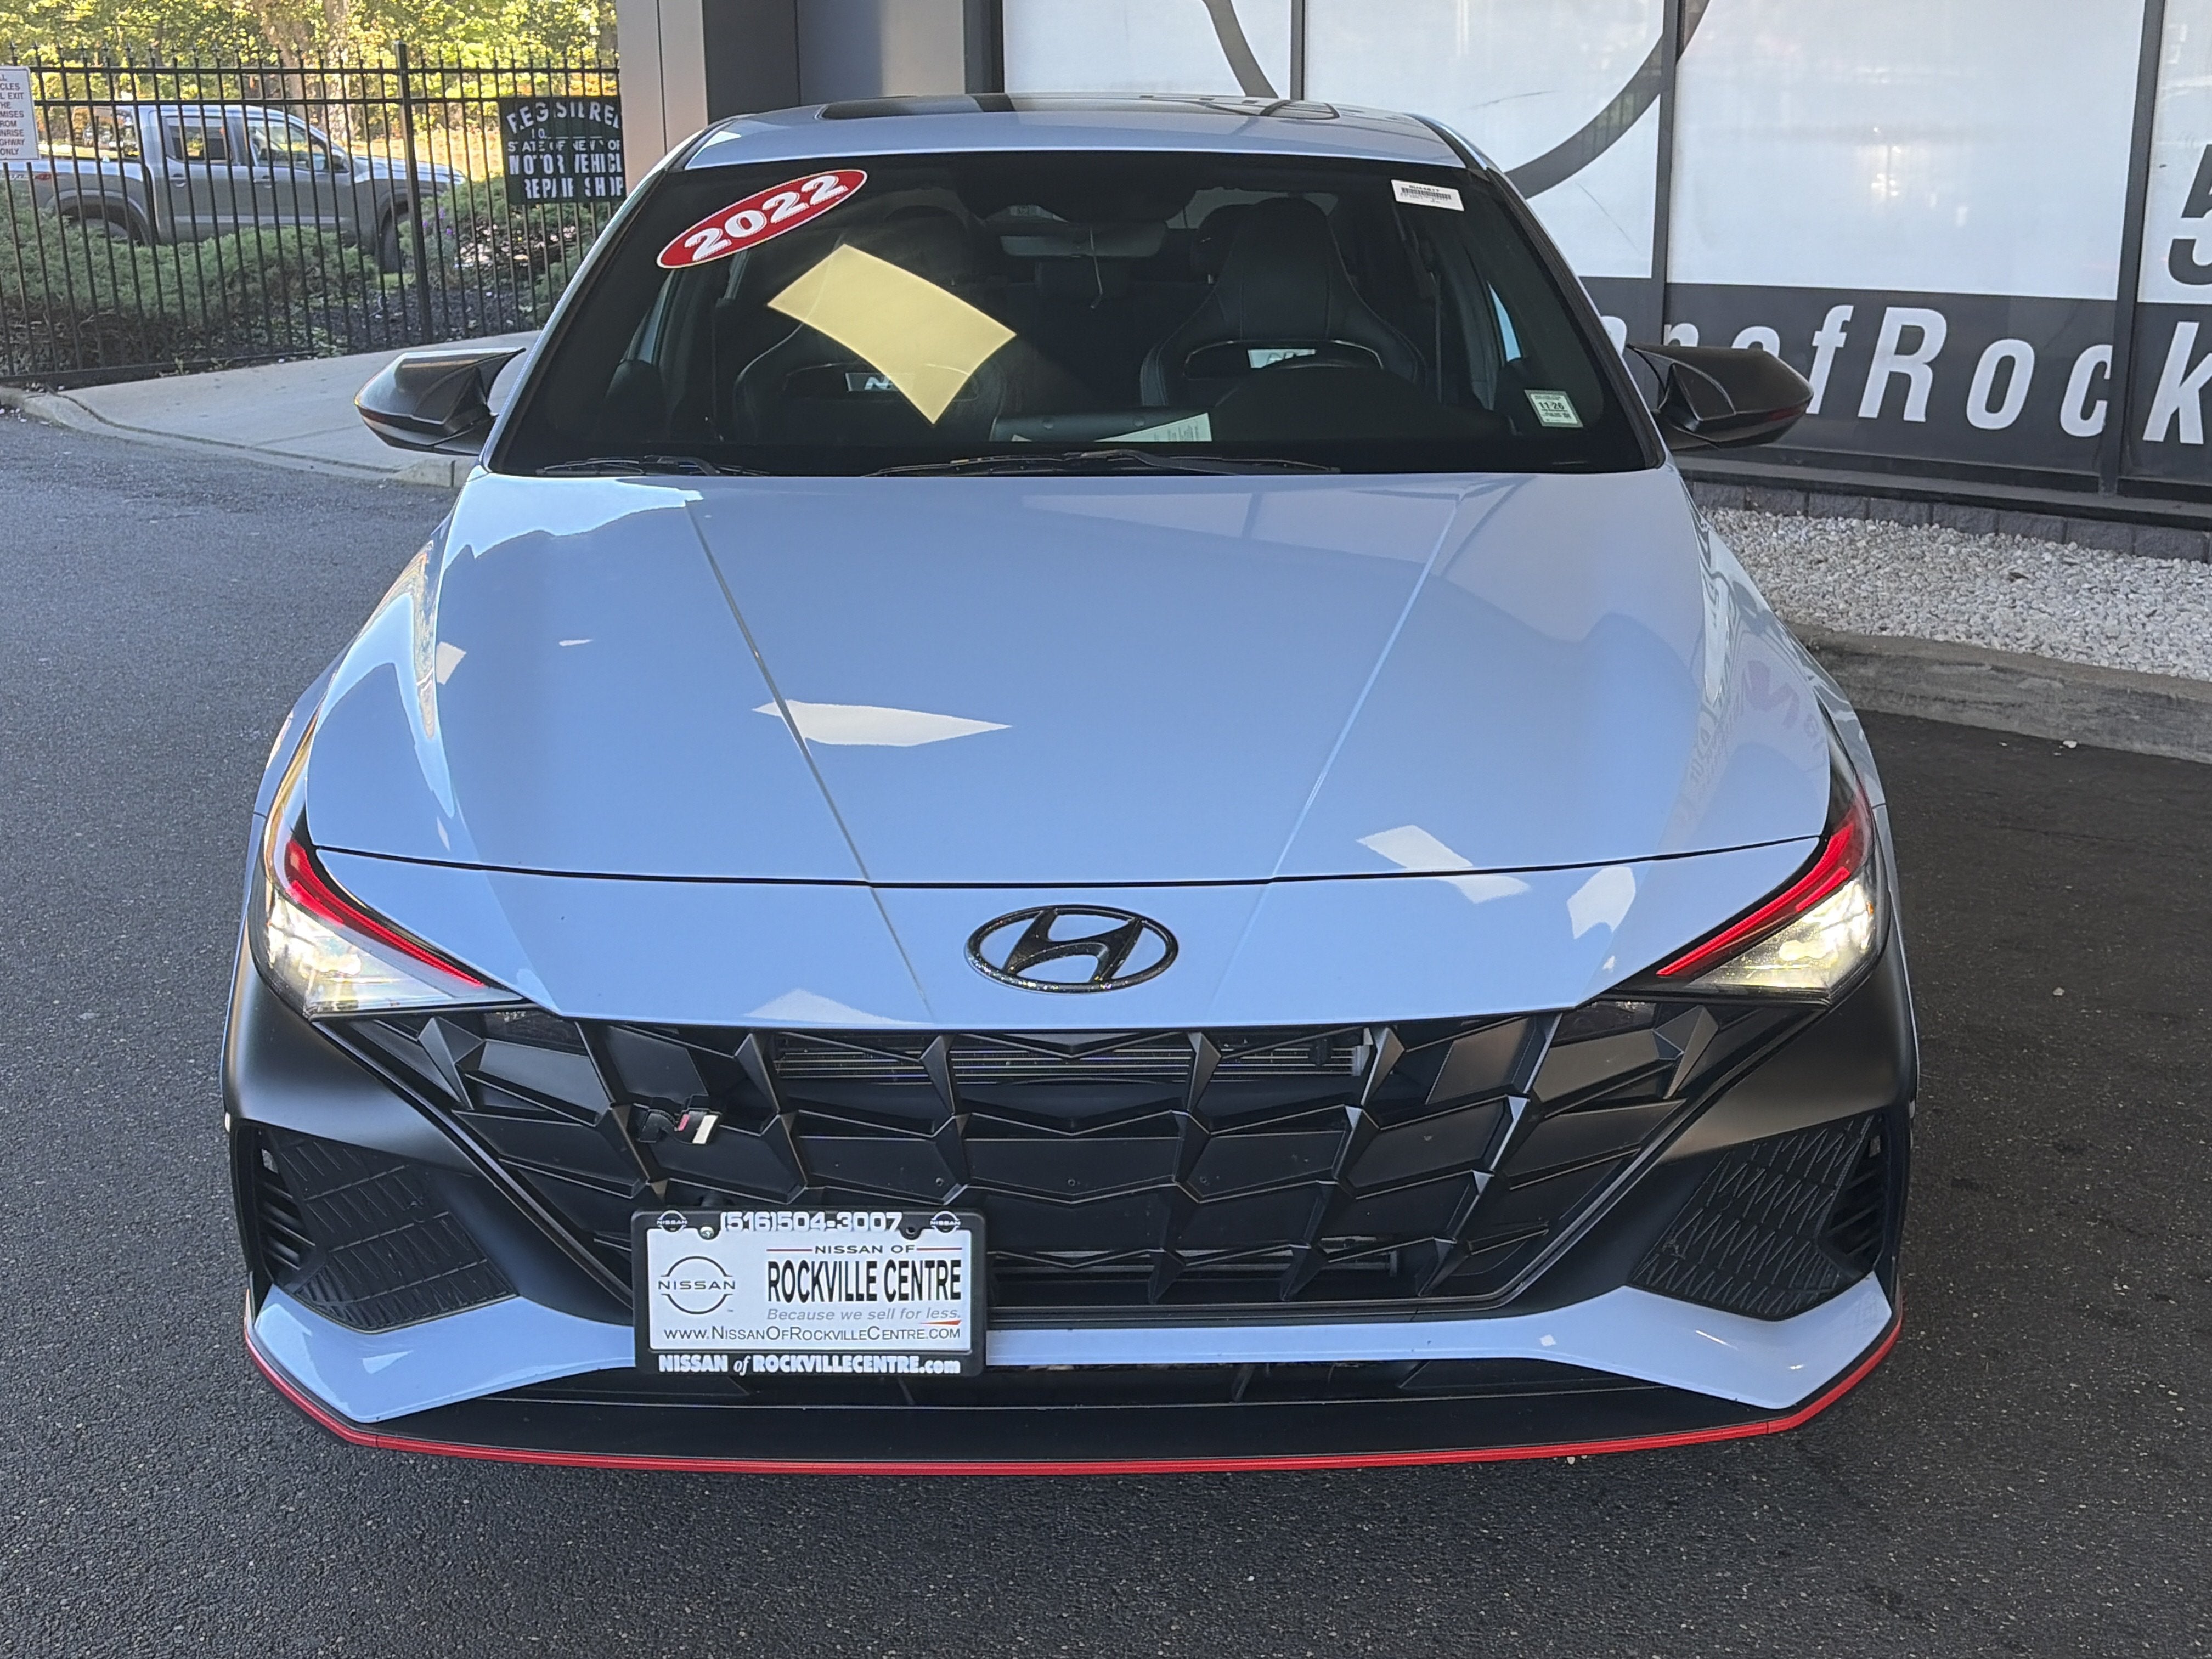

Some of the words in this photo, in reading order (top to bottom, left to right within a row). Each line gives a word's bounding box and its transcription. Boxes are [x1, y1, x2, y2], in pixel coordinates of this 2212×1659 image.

[684, 175, 848, 262] 2022
[720, 1211, 902, 1232] (516)504-3007
[815, 1245, 883, 1254] NISSAN
[890, 1245, 915, 1254] OF
[658, 1280, 736, 1290] NISSAN
[768, 1260, 878, 1304] ROCKVILLE
[884, 1259, 962, 1302] CENTRE
[768, 1309, 835, 1321] Because
[840, 1311, 862, 1321] we
[867, 1308, 895, 1320] sell
[899, 1308, 922, 1319] for
[659, 1355, 728, 1372] NISSAN
[733, 1355, 751, 1376] of
